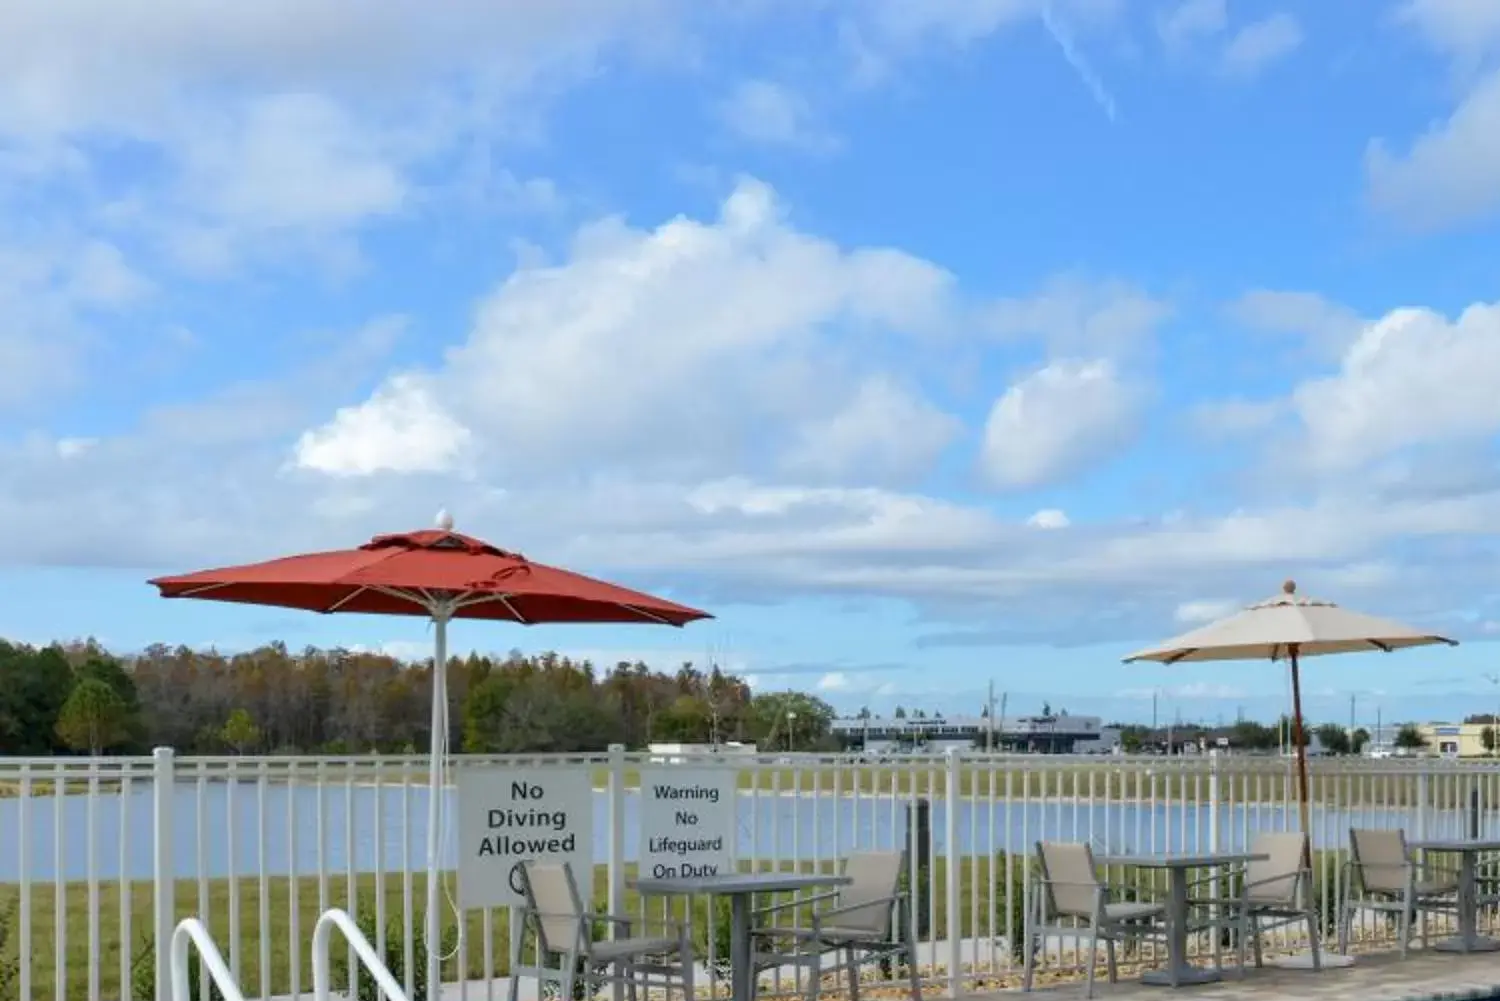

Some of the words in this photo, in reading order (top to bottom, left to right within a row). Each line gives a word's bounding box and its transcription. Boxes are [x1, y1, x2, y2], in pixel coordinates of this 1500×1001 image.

[511, 782, 544, 800] No
[654, 786, 719, 802] Warning
[488, 809, 566, 830] Diving
[675, 812, 699, 825] No
[479, 834, 576, 856] Allowed
[649, 837, 722, 855] Lifeguard
[653, 864, 676, 879] On
